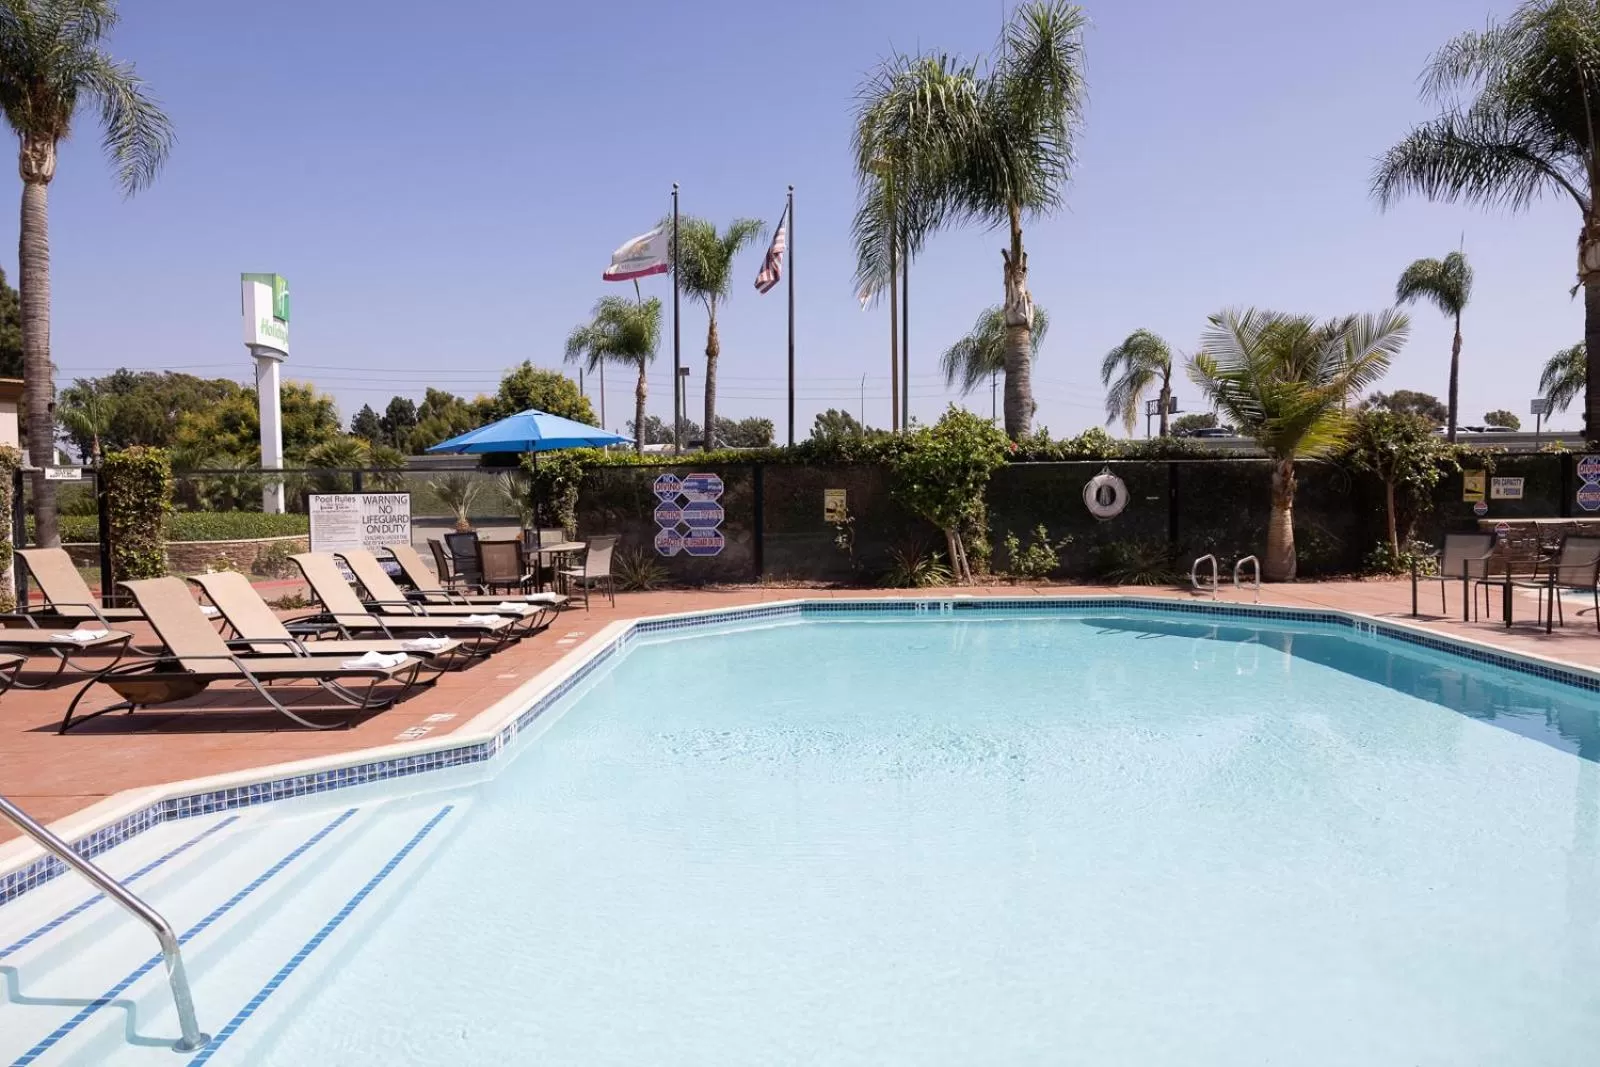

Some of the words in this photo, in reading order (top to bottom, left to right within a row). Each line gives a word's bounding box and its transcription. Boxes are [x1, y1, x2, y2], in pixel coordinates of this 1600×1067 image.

[662, 475, 673, 483] NO
[656, 482, 681, 491] DIVING
[315, 495, 333, 503] Pool
[334, 495, 357, 503] Rules
[362, 495, 408, 504] WARNING
[378, 505, 393, 514] NO
[362, 514, 409, 524] LIFEGUARD
[366, 525, 381, 534] ON
[382, 524, 406, 533] DUTY
